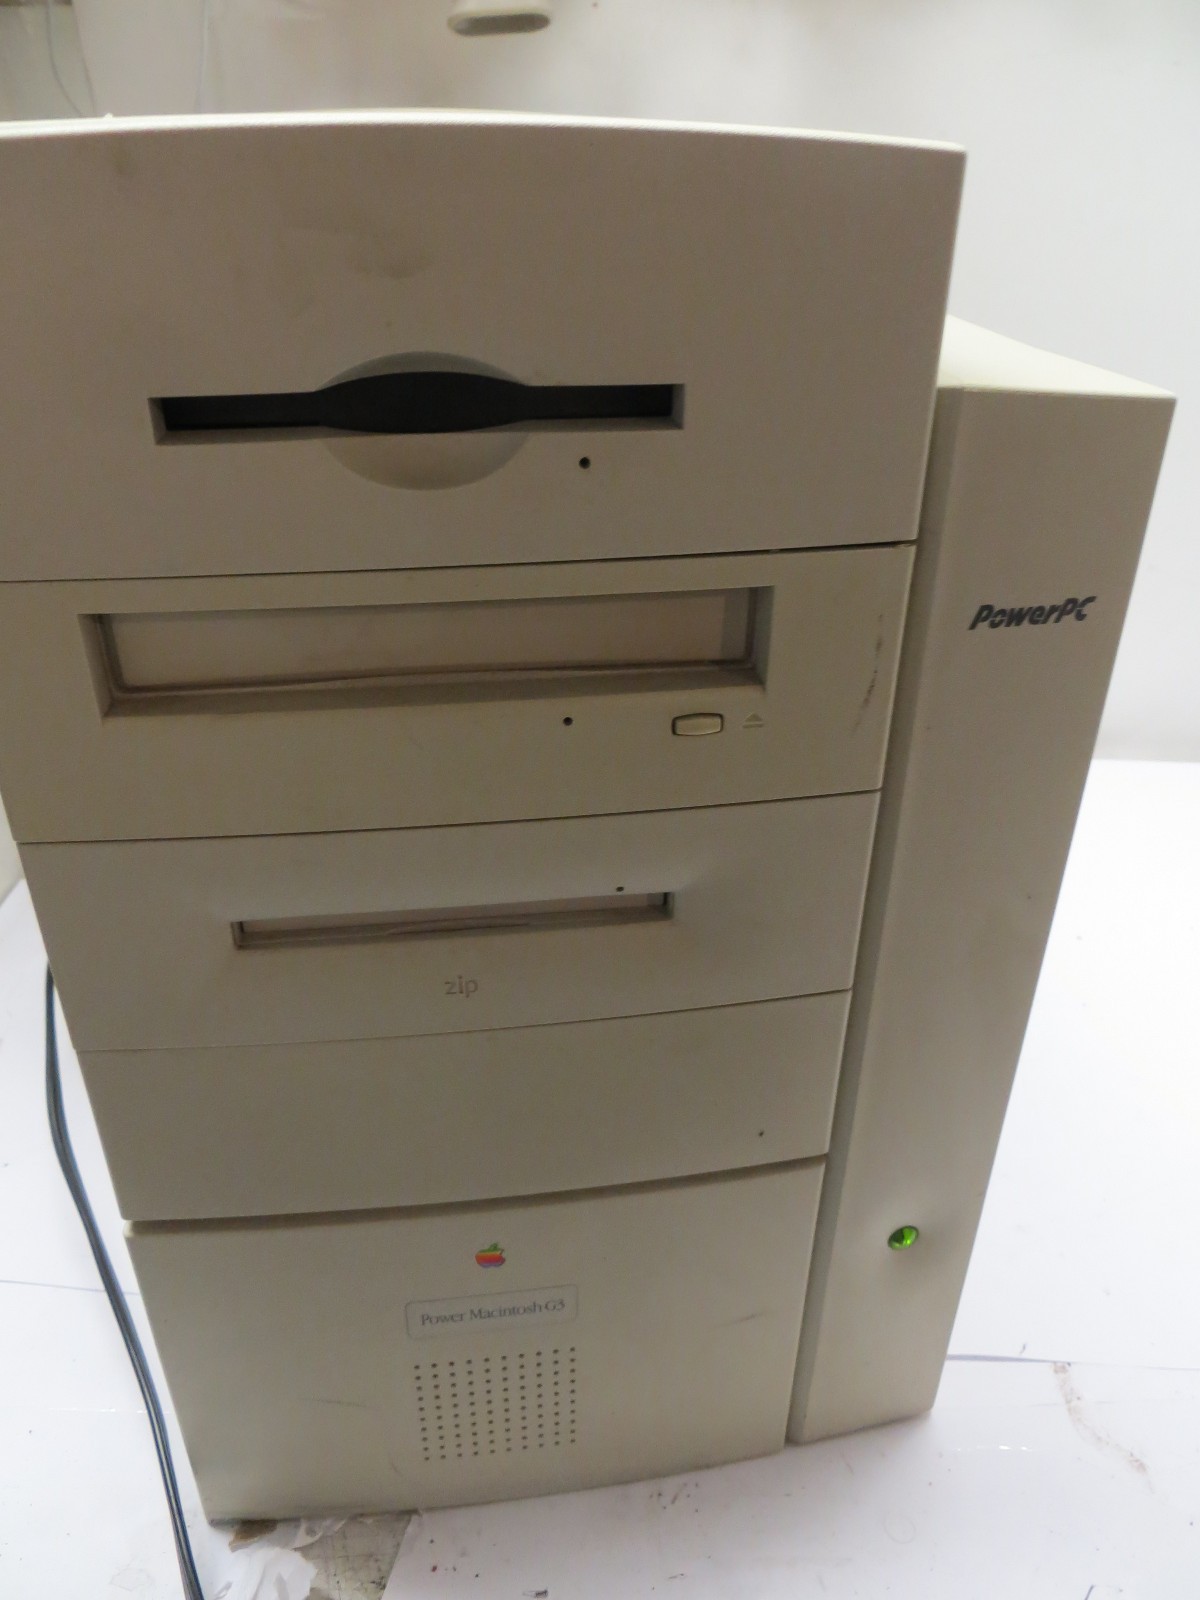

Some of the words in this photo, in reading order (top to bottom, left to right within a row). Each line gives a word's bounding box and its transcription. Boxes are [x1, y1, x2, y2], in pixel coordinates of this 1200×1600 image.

[968, 595, 1097, 630] PowerPC
[444, 975, 479, 998] zip
[421, 1312, 465, 1326] Power
[470, 1301, 542, 1320] Macintosh
[544, 1298, 566, 1312] G3
